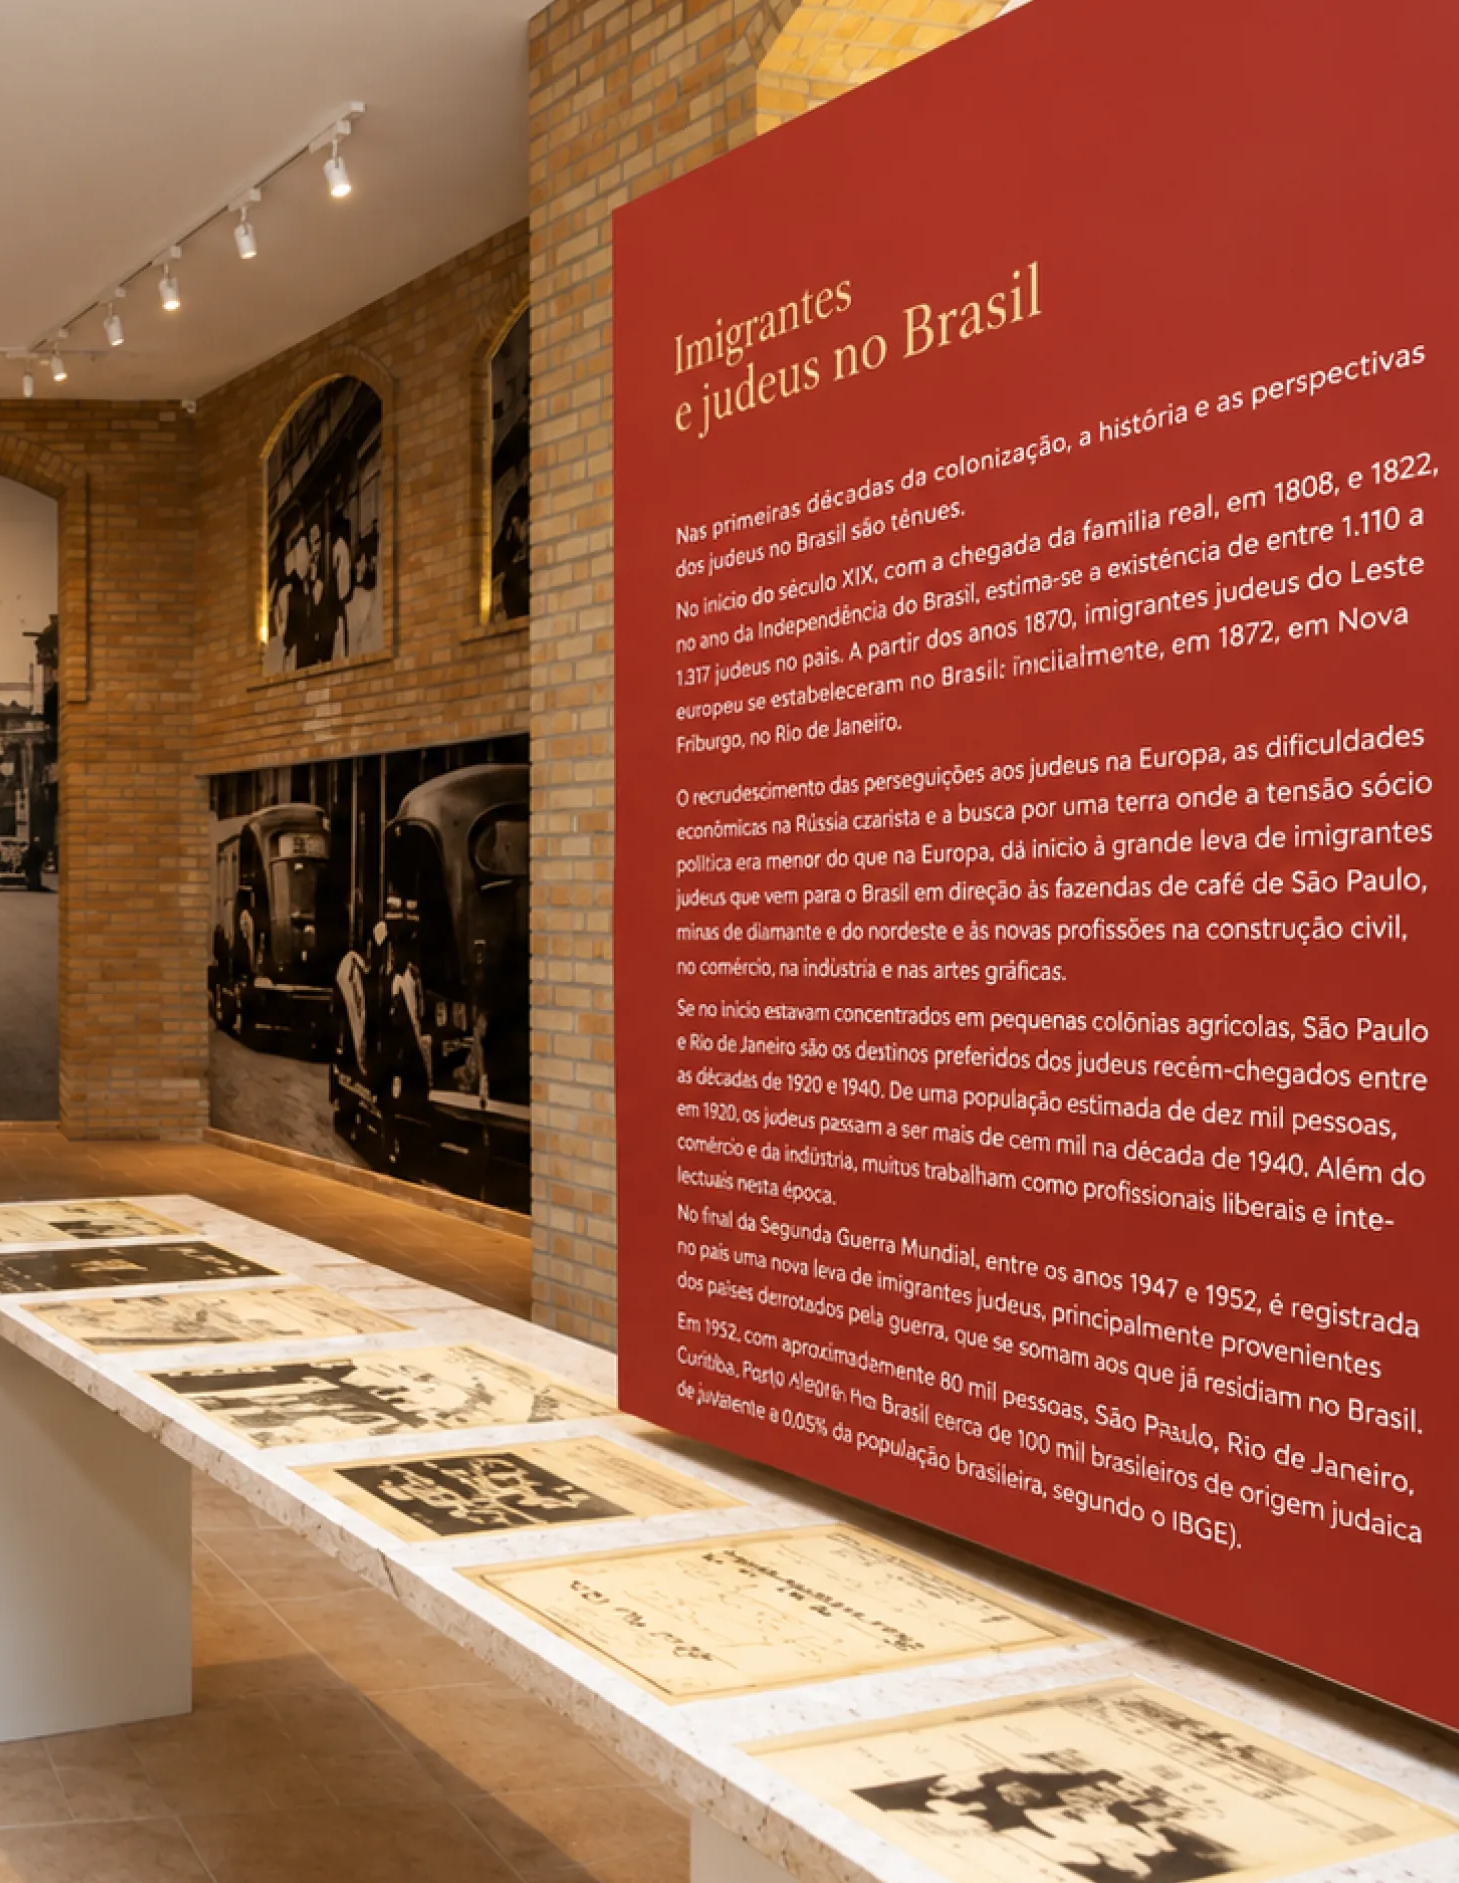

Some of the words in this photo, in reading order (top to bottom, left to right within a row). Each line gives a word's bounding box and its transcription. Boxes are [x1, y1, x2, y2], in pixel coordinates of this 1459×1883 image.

[674, 279, 852, 375] Imigrantes
[674, 401, 692, 432] e
[697, 355, 820, 439] judeus
[833, 333, 888, 382] no
[902, 260, 1042, 358] Brasil
[1098, 401, 1188, 442] história
[1193, 399, 1210, 418] e
[1215, 389, 1244, 413] as
[1251, 343, 1426, 410] perspectivas
[795, 520, 846, 553] Brasil
[882, 557, 927, 581] com
[948, 531, 1041, 568] chegada
[1167, 492, 1220, 525] real,
[1225, 488, 1266, 513] em
[1273, 470, 1340, 503] 1808,
[1346, 470, 1364, 489] e
[1370, 450, 1439, 485] 1822,
[984, 568, 1083, 601] estima-se
[1088, 564, 1101, 583] a
[1226, 532, 1260, 558] de
[1265, 522, 1334, 551] entre
[1341, 504, 1400, 537] 1.110
[1407, 506, 1424, 527] a
[867, 630, 921, 664] partir
[925, 626, 963, 650] dos
[967, 619, 1018, 643] anos
[1084, 588, 1209, 625] imigrantes
[1212, 574, 1300, 611] judeus
[1305, 564, 1342, 591] do
[1349, 552, 1425, 585] Leste
[769, 676, 904, 708] estabeleceram
[1170, 632, 1210, 655] em
[1217, 618, 1280, 649] 1872,
[1287, 616, 1328, 640] em
[1337, 605, 1409, 633] Nova
[774, 722, 803, 744] Rio
[988, 762, 1025, 782] aos
[1026, 753, 1099, 784] judeus
[1104, 753, 1132, 772] na
[1138, 745, 1227, 772] Europa,
[1231, 741, 1260, 762] as
[1264, 723, 1425, 760] dificuldades
[957, 801, 1015, 824] busca
[1020, 800, 1057, 824] por
[1062, 796, 1109, 816] uma
[1114, 791, 1169, 814] terra
[1175, 783, 1238, 810] onde
[1265, 775, 1354, 804] tensão
[1360, 769, 1433, 798] sócio
[765, 852, 822, 870] menor
[1111, 829, 1194, 861] grande
[1199, 827, 1248, 851] leva
[1253, 823, 1286, 850] de
[1293, 819, 1433, 852] imigrantes
[802, 887, 842, 910] para
[861, 881, 909, 903] Brasil
[947, 878, 1023, 906] direção
[1054, 874, 1153, 899] fazendas
[1156, 873, 1189, 897] de
[1193, 870, 1245, 896] café
[1251, 870, 1284, 895] de
[1290, 868, 1338, 894] São
[1346, 865, 1427, 894] Paulo,
[867, 920, 948, 941] nordeste
[993, 922, 1052, 941] novas
[1056, 916, 1166, 945] profissões
[1171, 922, 1200, 941] na
[1205, 914, 1344, 947] construção
[1349, 912, 1408, 942] civil,
[896, 962, 929, 979] nas
[931, 960, 981, 981] artes
[833, 1004, 952, 1027] concentrados
[989, 1011, 1087, 1035] pequenas
[1301, 1014, 1349, 1041] São
[1355, 1016, 1429, 1043] Paulo
[853, 1038, 929, 1064] destinos
[933, 1044, 1031, 1070] preferidos
[1034, 1048, 1072, 1073] dos
[1074, 1050, 1147, 1078] judeus
[1152, 1054, 1352, 1090] recém-chegados
[1357, 1066, 1428, 1092] entre
[785, 1072, 823, 1094] 1920
[917, 1086, 959, 1105] uma
[962, 1087, 1063, 1117] população
[1066, 1093, 1161, 1120] estimada
[1166, 1097, 1196, 1122] de
[1201, 1099, 1243, 1126] dez
[1248, 1104, 1284, 1129] mil
[1291, 1111, 1397, 1141] pessoas,
[900, 1122, 929, 1140] ser
[931, 1123, 975, 1145] mais
[1007, 1133, 1051, 1152] cem
[1055, 1132, 1087, 1156] mil
[1091, 1140, 1117, 1159] na
[1122, 1137, 1205, 1168] década
[1210, 1145, 1242, 1170] de
[1315, 1154, 1383, 1184] Além
[1389, 1159, 1426, 1188] do
[923, 1160, 1017, 1190] trabalham
[1020, 1174, 1079, 1198] como
[1082, 1177, 1216, 1213] profissionais
[1221, 1191, 1306, 1222] liberais
[1334, 1201, 1395, 1232] inte-
[759, 1213, 832, 1244] Segunda
[835, 1225, 896, 1254] Guerra
[984, 1253, 1039, 1278] entre
[1072, 1267, 1123, 1291] anos
[1128, 1271, 1179, 1299] 1947
[1204, 1283, 1262, 1316] 1952,
[1290, 1300, 1419, 1338] registrada
[770, 1255, 809, 1276] nova
[812, 1257, 846, 1282] leva
[875, 1269, 973, 1306] imigrantes
[1051, 1302, 1214, 1350] principalmente
[1220, 1334, 1382, 1379] provenientes
[847, 1304, 884, 1328] pela
[953, 1327, 989, 1349] que
[1018, 1339, 1089, 1369] somam
[1092, 1353, 1129, 1377] aos
[1132, 1361, 1175, 1385] que
[1203, 1374, 1302, 1410] residiam
[1307, 1394, 1340, 1417] no
[1347, 1396, 1423, 1435] Brasil.
[881, 1392, 930, 1425] Brasil
[1016, 1428, 1051, 1455] 100
[1054, 1438, 1085, 1463] mil
[1090, 1442, 1198, 1489] brasileiros
[1203, 1471, 1234, 1499] de
[1238, 1482, 1324, 1521] origem
[1329, 1498, 1423, 1545] judaica
[967, 1379, 997, 1402] mil
[1093, 1402, 1137, 1433] São
[1227, 1430, 1266, 1461] Rio
[1273, 1442, 1306, 1469] de
[1309, 1450, 1414, 1497] Janeiro,
[1052, 1482, 1145, 1522] segundo
[1171, 1509, 1242, 1551] IBGE).
